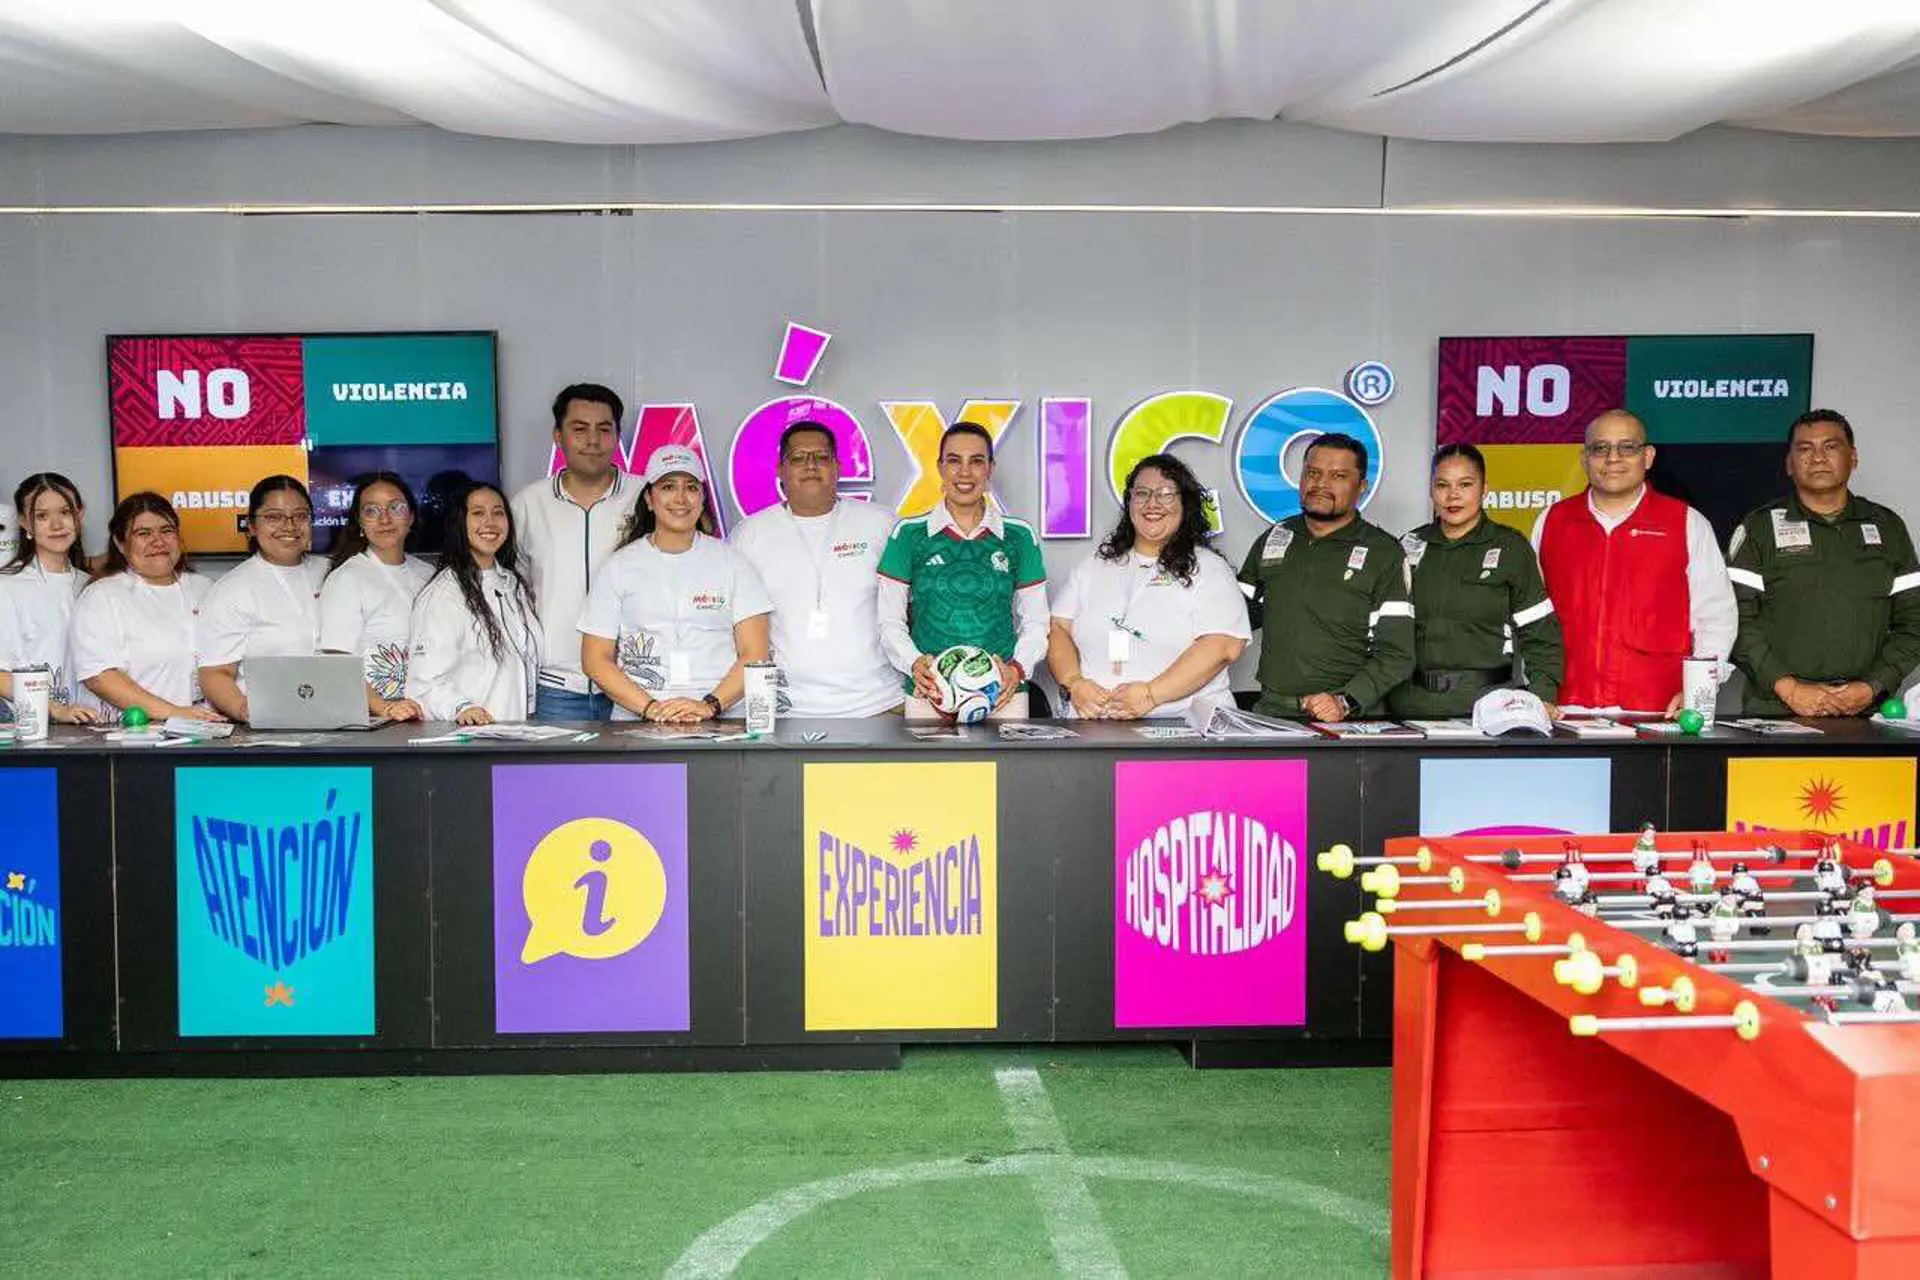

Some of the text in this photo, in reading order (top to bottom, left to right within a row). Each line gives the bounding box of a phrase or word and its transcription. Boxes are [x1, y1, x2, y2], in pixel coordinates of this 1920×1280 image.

[157, 368, 250, 419] NO
[332, 382, 467, 402] VIOLENCIA
[1476, 364, 1571, 417] NO
[1654, 379, 1789, 398] VIOLENCIA
[171, 490, 250, 509] ABUSO
[1482, 489, 1561, 509] ABUSO
[192, 788, 361, 972] ATENCIÓN
[818, 830, 982, 937] EXPERIENCIA
[1125, 810, 1297, 956] HOSPITALIDAD
